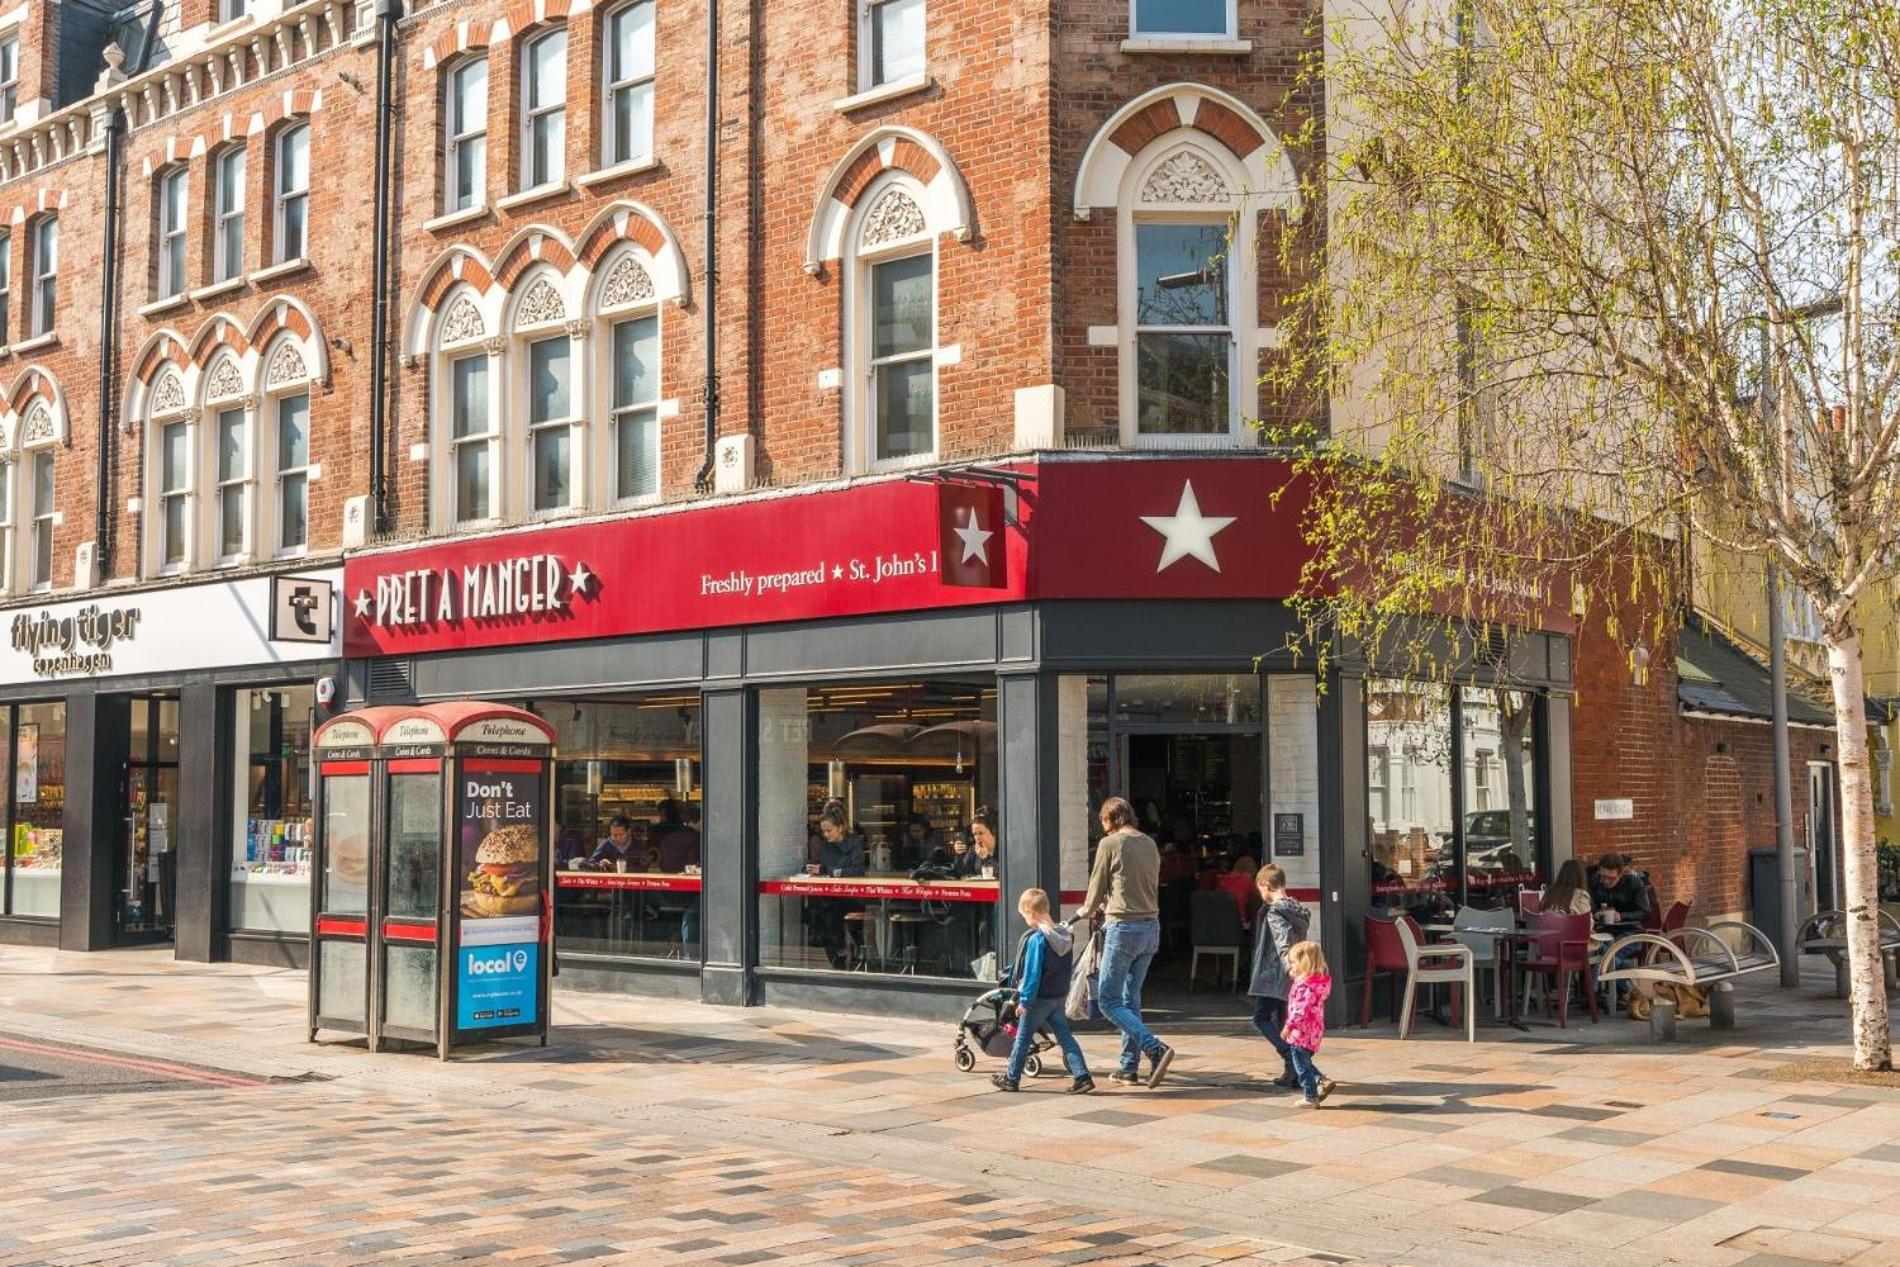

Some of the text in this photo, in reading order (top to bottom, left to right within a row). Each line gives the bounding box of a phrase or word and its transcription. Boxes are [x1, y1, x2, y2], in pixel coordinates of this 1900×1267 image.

[701, 571, 752, 595] Freshly
[757, 561, 825, 595] prepared
[849, 559, 870, 580] St.
[873, 553, 927, 583] John's
[377, 554, 561, 626] PRET A MANGER
[11, 604, 141, 658] flying tiger
[33, 652, 112, 677] copenhagen
[482, 724, 526, 738] Telephone
[466, 781, 514, 798] Don't
[466, 801, 532, 818] Just Eat
[467, 950, 512, 975] local
